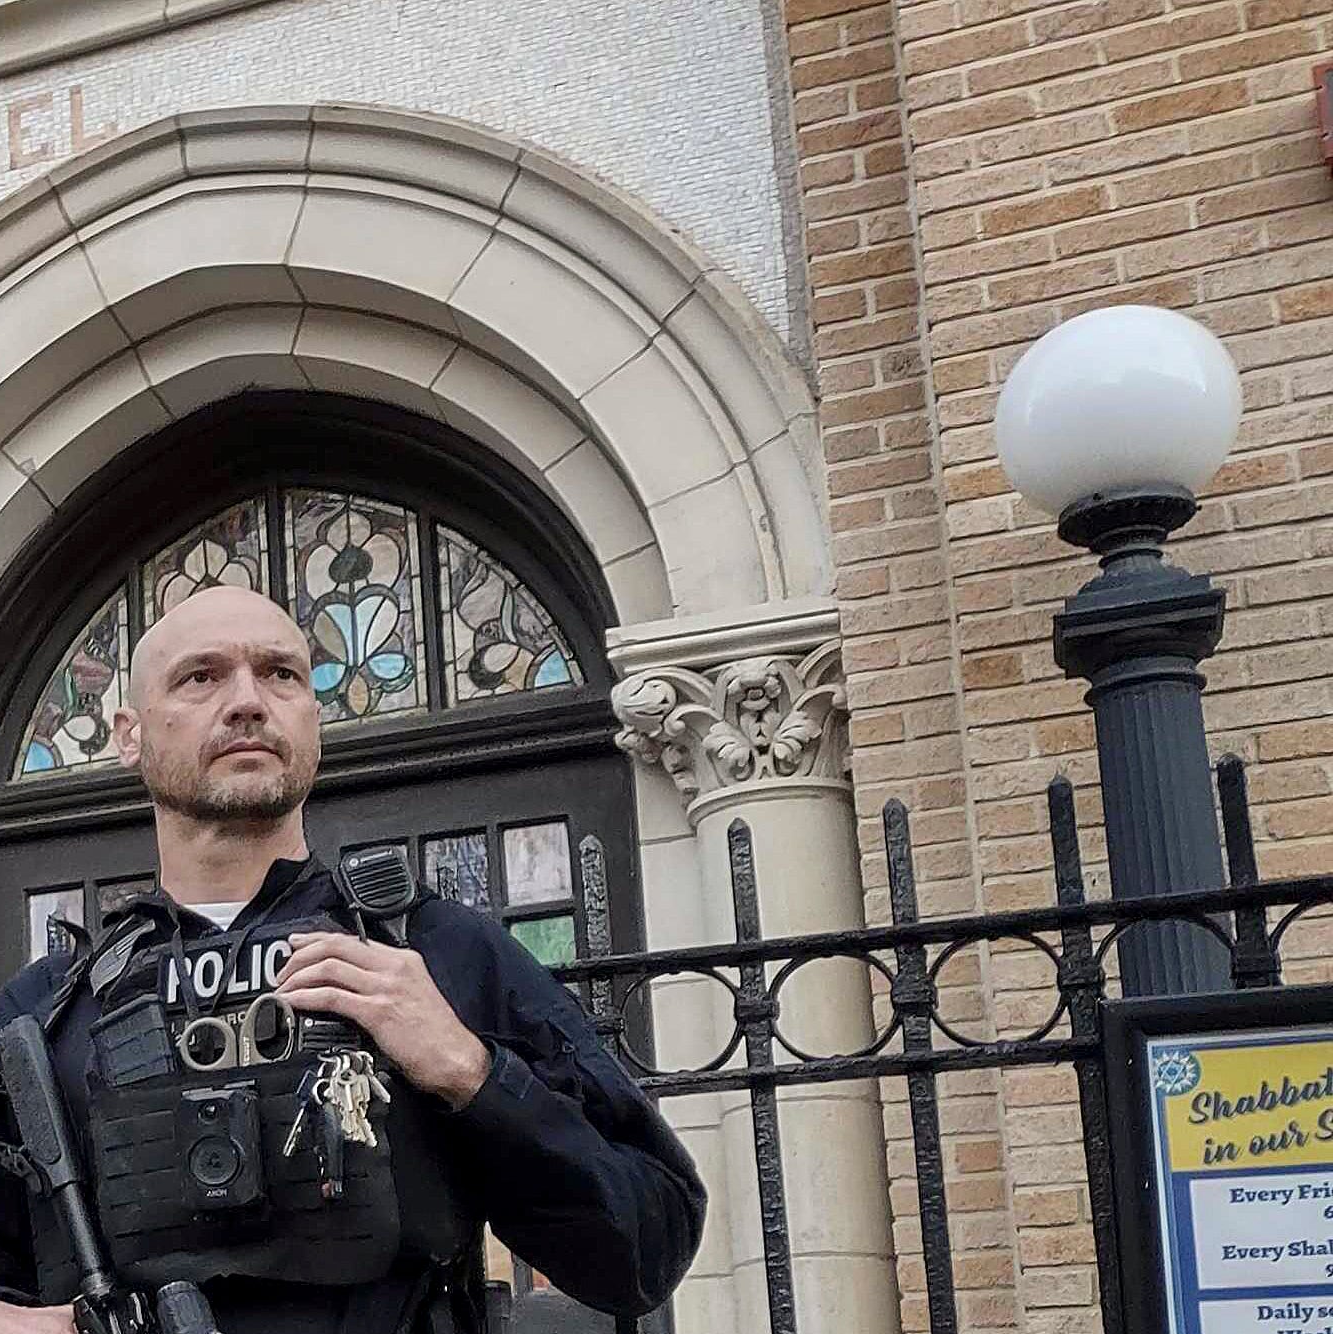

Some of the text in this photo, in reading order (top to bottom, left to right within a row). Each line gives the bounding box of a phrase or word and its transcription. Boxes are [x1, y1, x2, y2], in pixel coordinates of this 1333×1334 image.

[167, 939, 292, 1004] POLIC
[1203, 1138, 1241, 1165] in
[1249, 1120, 1310, 1156] our
[1229, 1181, 1333, 1206] Every Fri
[1221, 1244, 1284, 1263] Every
[1257, 1302, 1314, 1324] Daily
